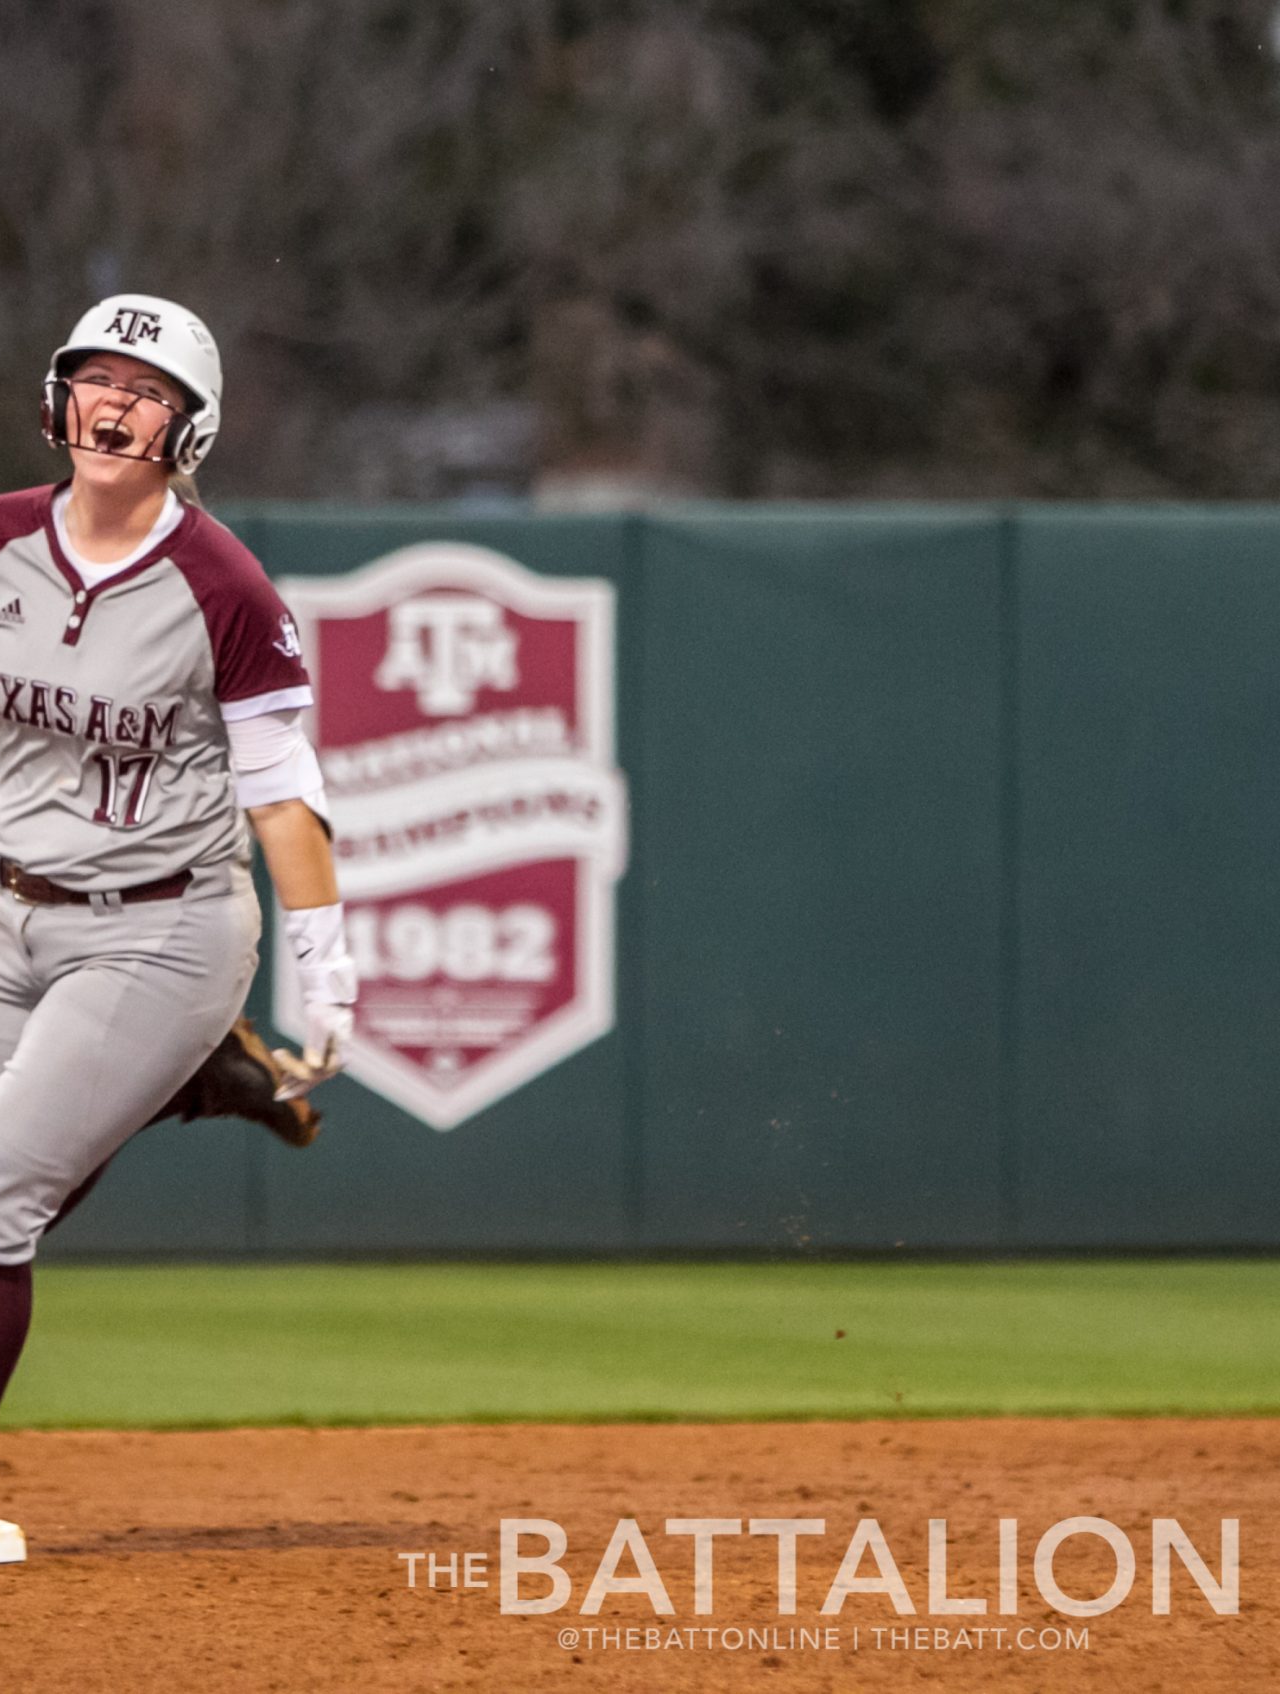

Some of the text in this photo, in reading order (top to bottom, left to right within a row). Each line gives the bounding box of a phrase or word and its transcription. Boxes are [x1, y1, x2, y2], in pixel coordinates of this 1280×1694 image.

[84, 695, 184, 749] A&M
[91, 751, 159, 827] 17
[346, 905, 556, 983] 1982
